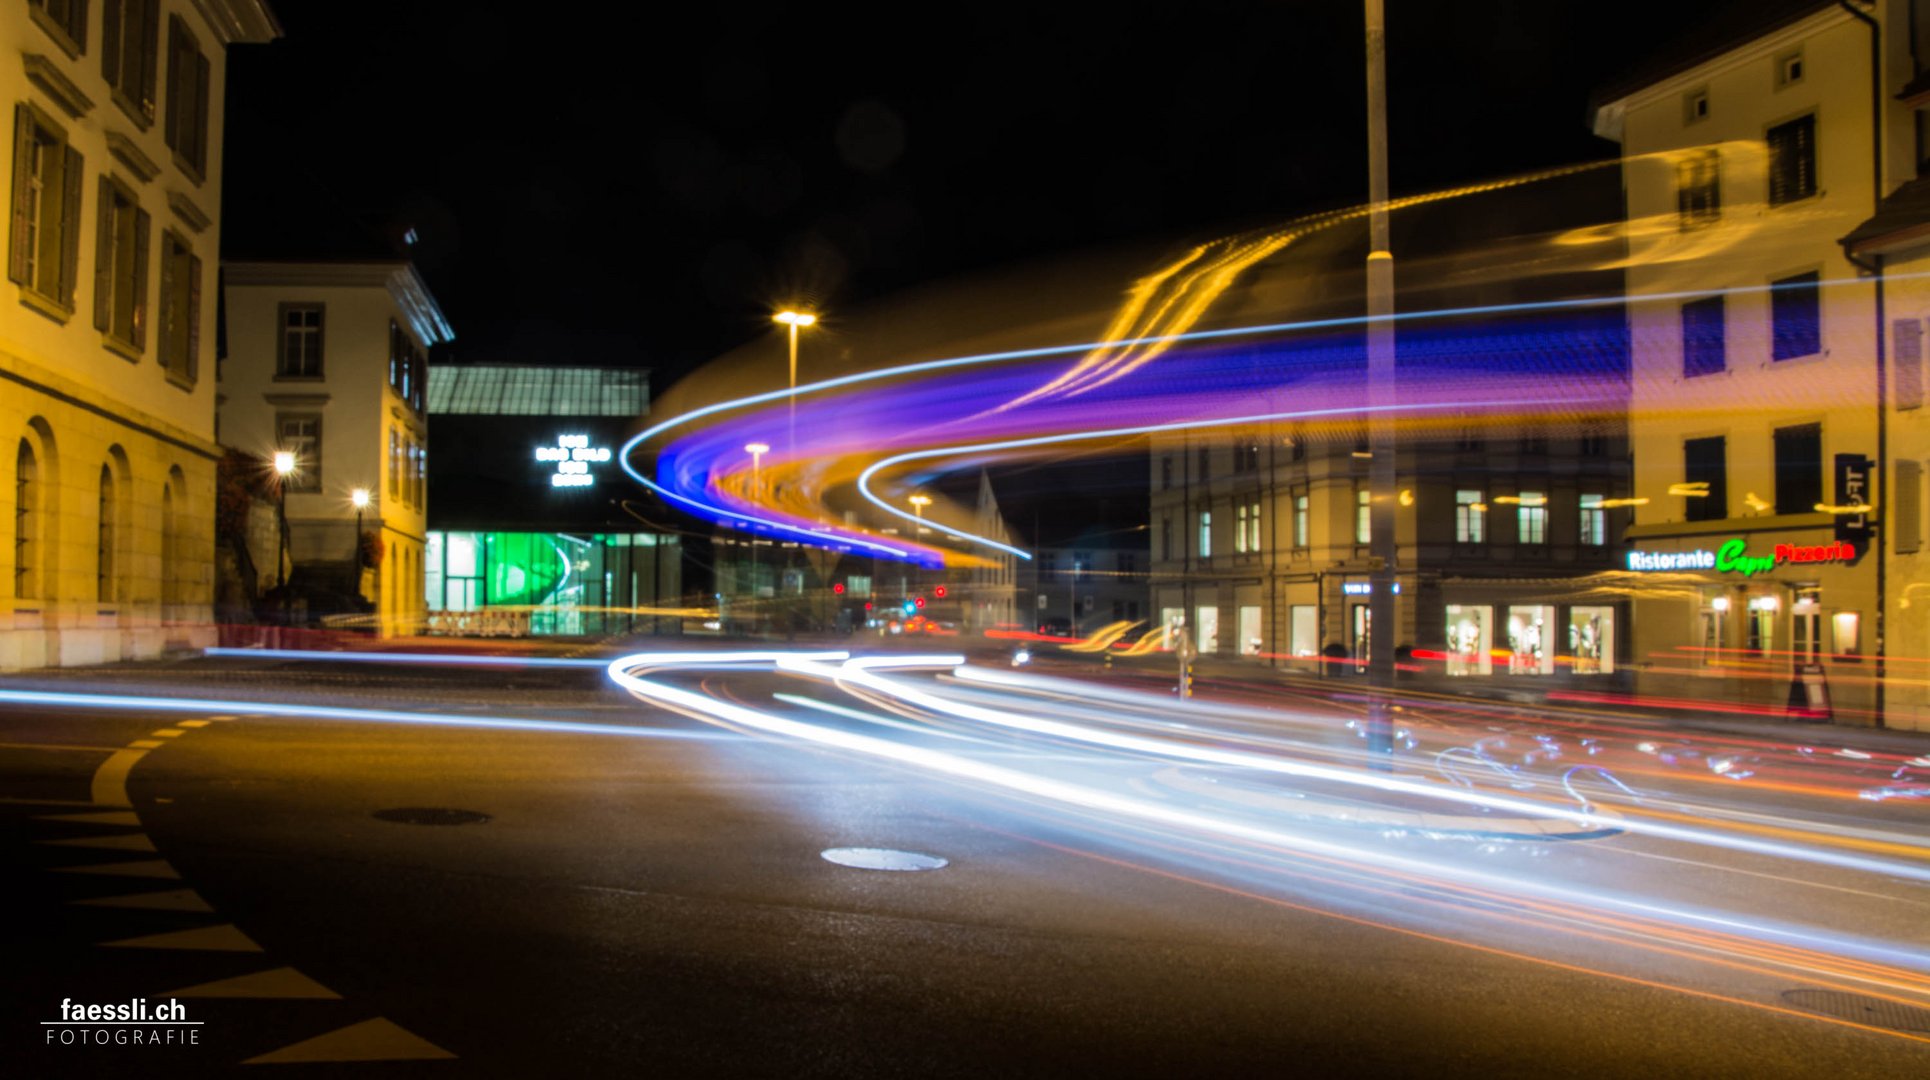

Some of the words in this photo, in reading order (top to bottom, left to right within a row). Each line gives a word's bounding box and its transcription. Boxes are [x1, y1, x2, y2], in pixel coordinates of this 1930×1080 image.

[1628, 550, 1715, 570] Ristorante
[1716, 539, 1775, 576] Capri
[1775, 541, 1855, 563] Pizzeria
